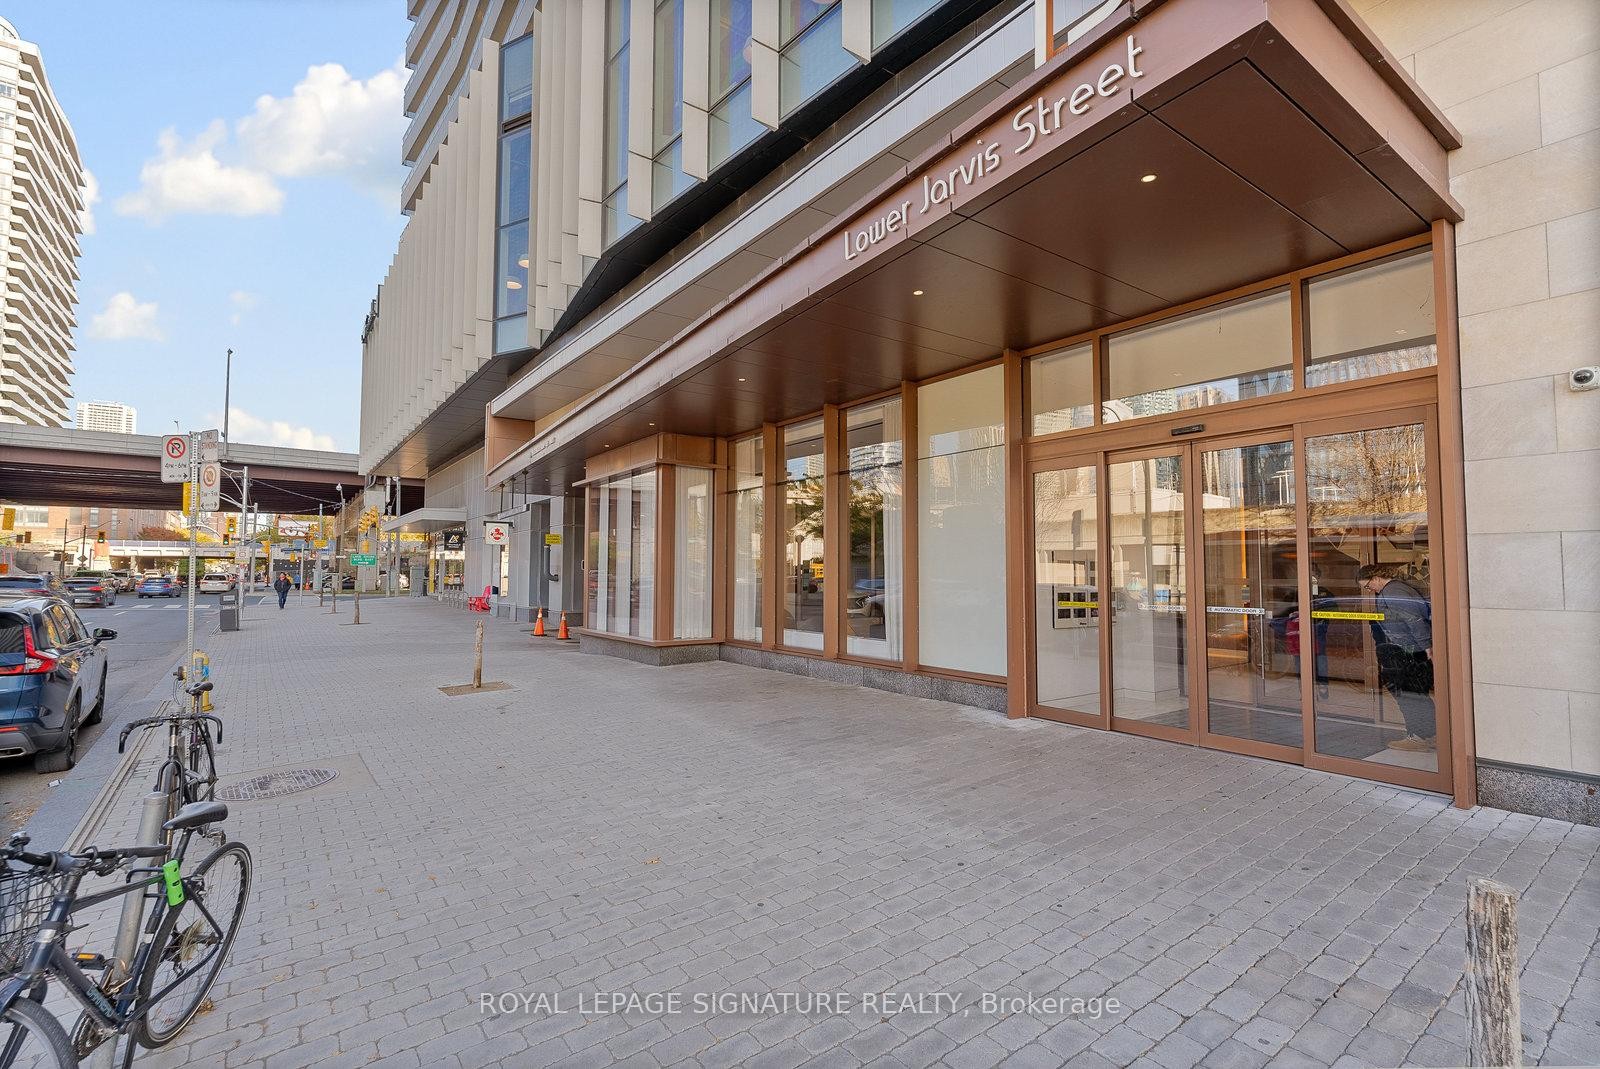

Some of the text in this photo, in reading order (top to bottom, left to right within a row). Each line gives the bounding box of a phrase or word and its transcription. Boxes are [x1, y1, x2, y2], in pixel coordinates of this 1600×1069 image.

[843, 199, 911, 261] Lower
[920, 138, 1002, 215] Jarvis
[1011, 34, 1144, 155] Street
